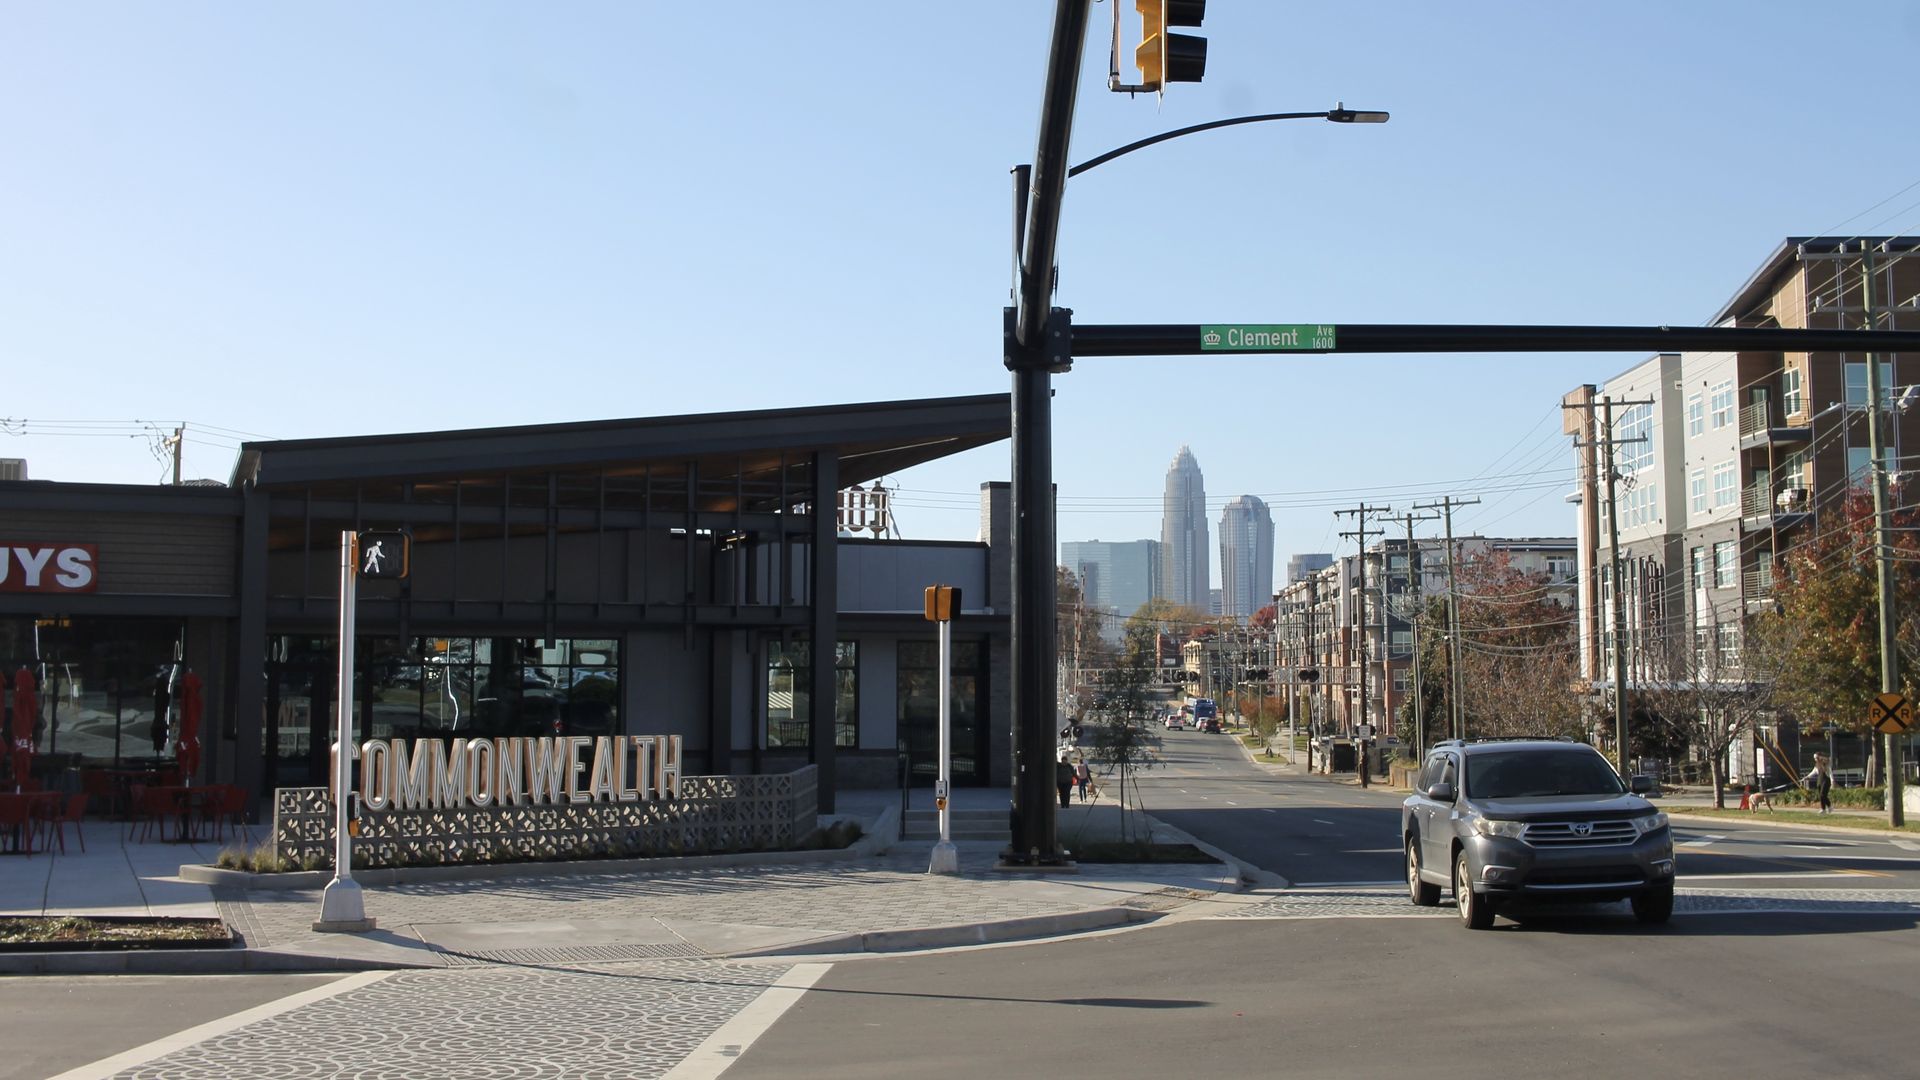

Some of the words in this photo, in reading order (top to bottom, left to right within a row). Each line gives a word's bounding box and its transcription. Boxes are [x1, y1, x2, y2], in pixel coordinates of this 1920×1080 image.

[1316, 325, 1333, 336] Ave
[1228, 328, 1298, 346] Clement
[1312, 337, 1333, 349] 1600
[0, 547, 92, 588] YS
[1872, 708, 1881, 718] R
[1901, 708, 1910, 719] R
